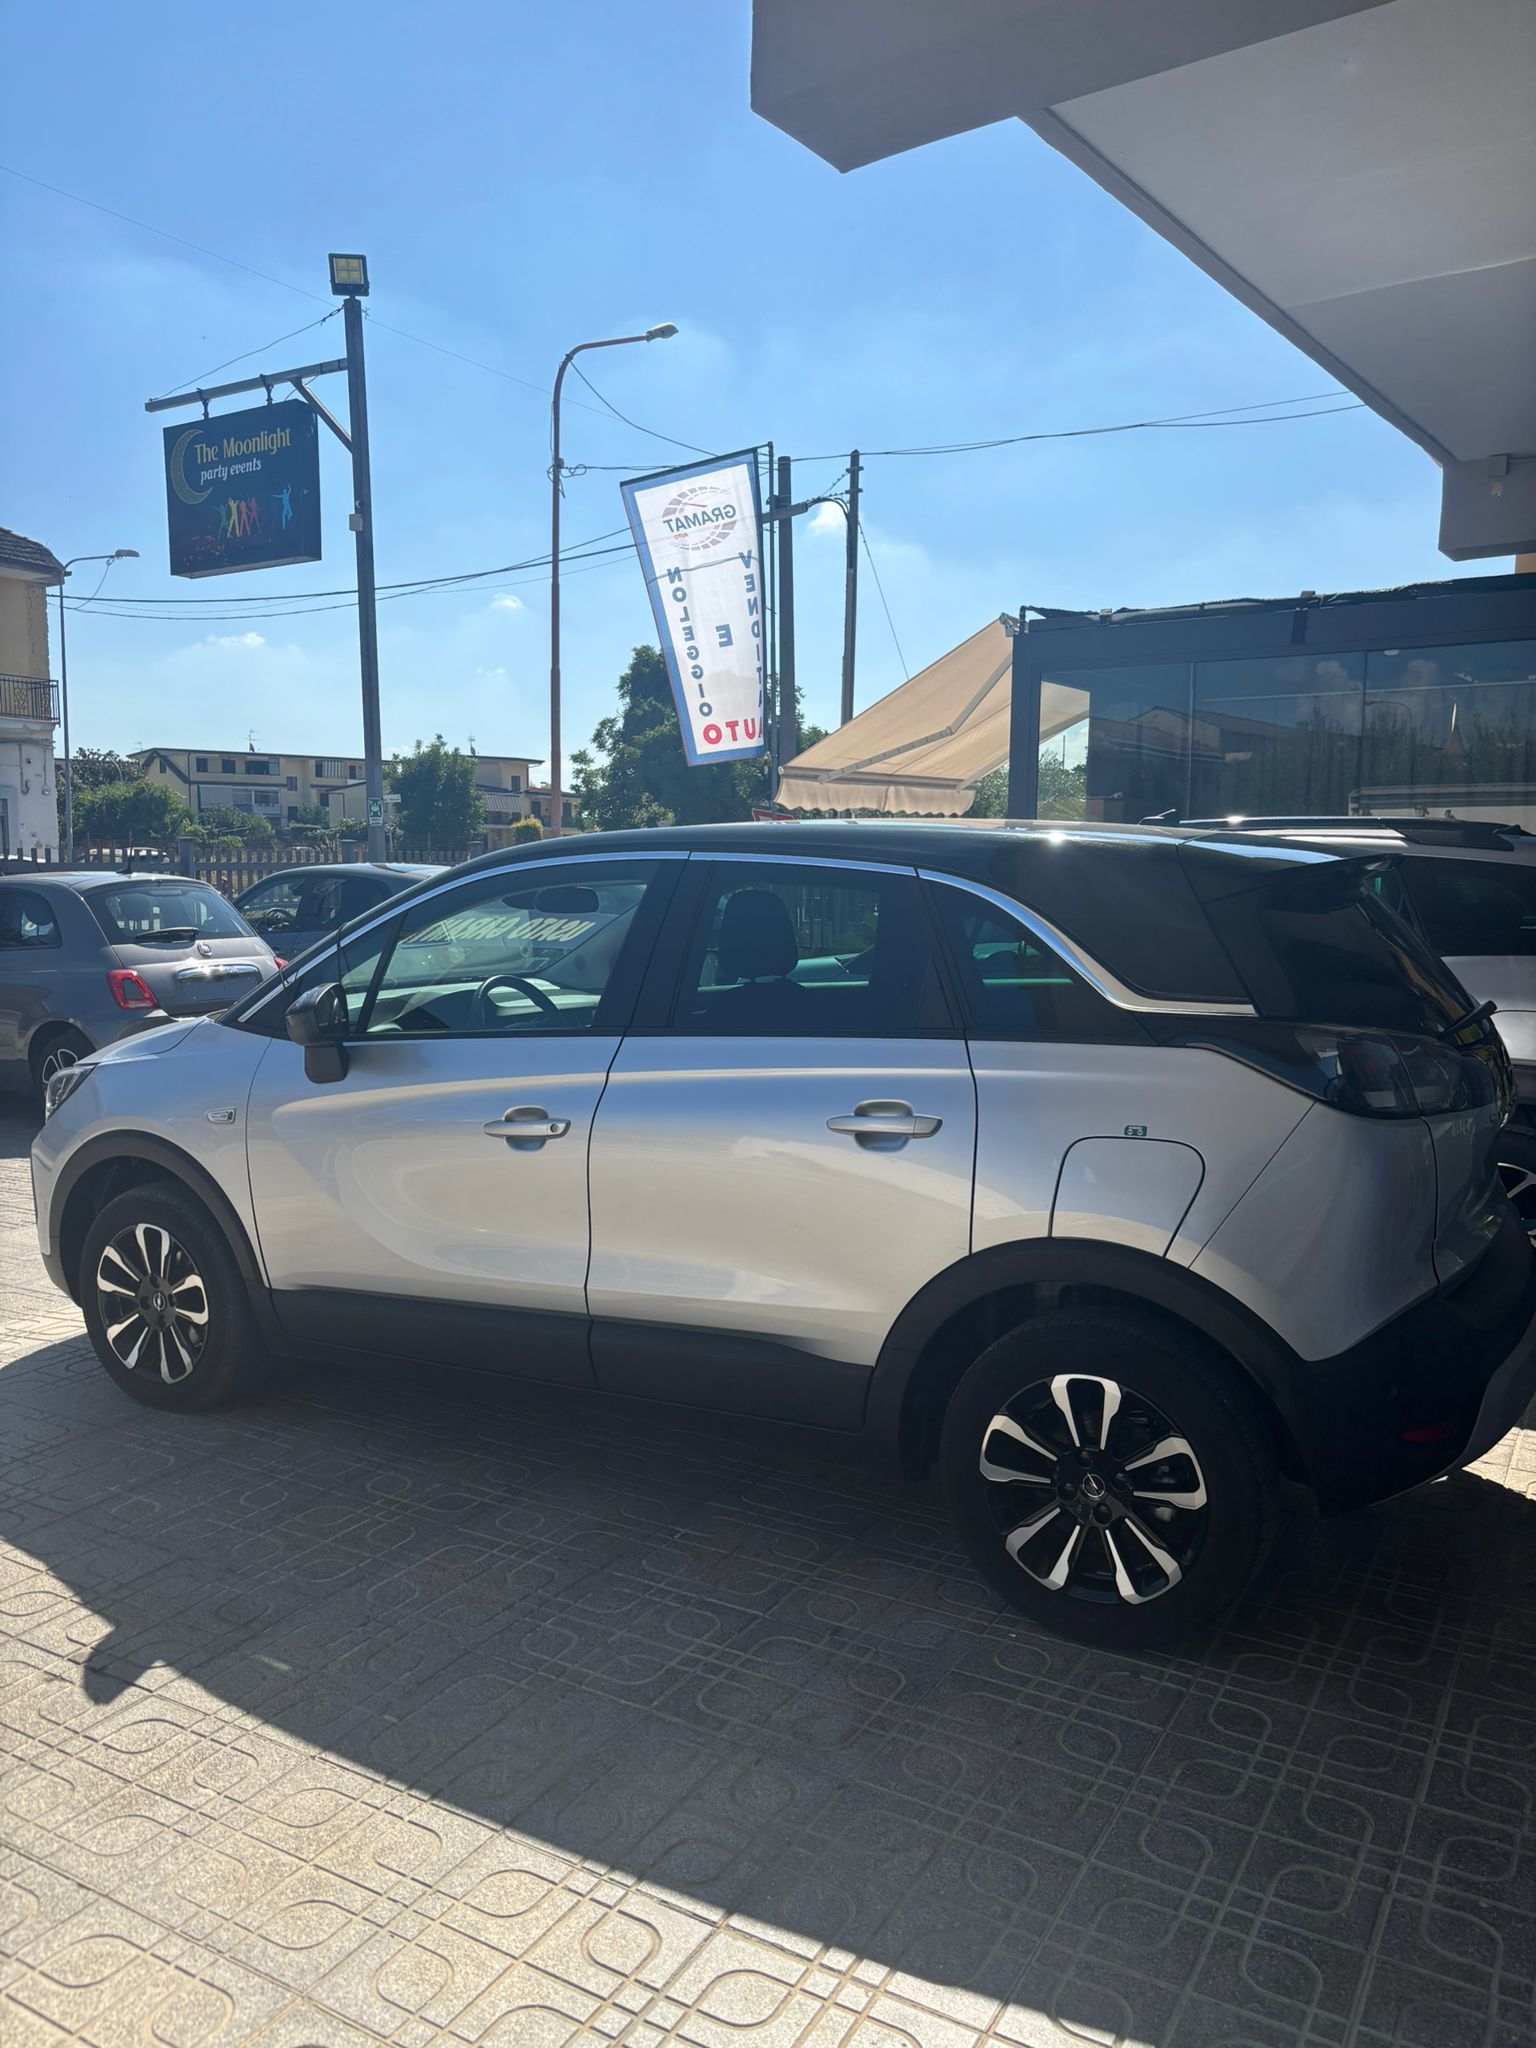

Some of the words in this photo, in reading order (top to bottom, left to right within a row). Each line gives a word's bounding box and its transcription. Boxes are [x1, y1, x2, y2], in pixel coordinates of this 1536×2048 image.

[194, 443, 219, 464] The
[223, 427, 291, 458] Moonlight
[200, 465, 228, 485] party
[230, 458, 262, 475] events
